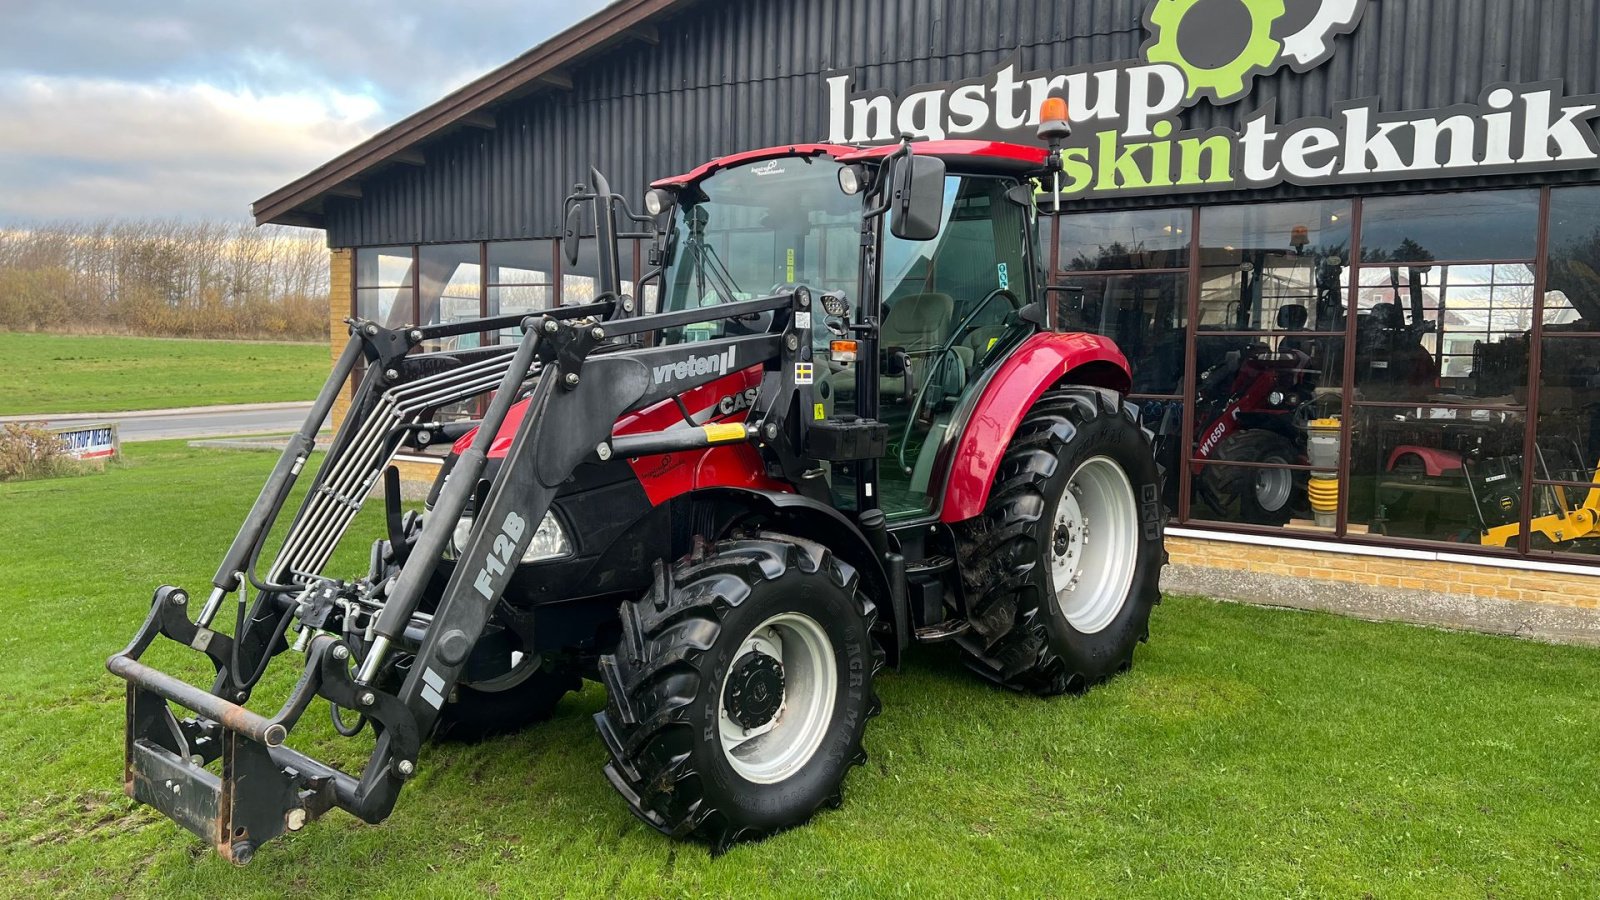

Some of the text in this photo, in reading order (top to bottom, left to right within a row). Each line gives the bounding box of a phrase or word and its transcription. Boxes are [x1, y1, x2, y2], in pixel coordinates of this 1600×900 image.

[825, 63, 1185, 145] Ingstrup
[719, 387, 762, 415] CAS
[1200, 421, 1226, 457] W1650
[1140, 482, 1161, 541] BKT
[473, 511, 526, 601] F12B
